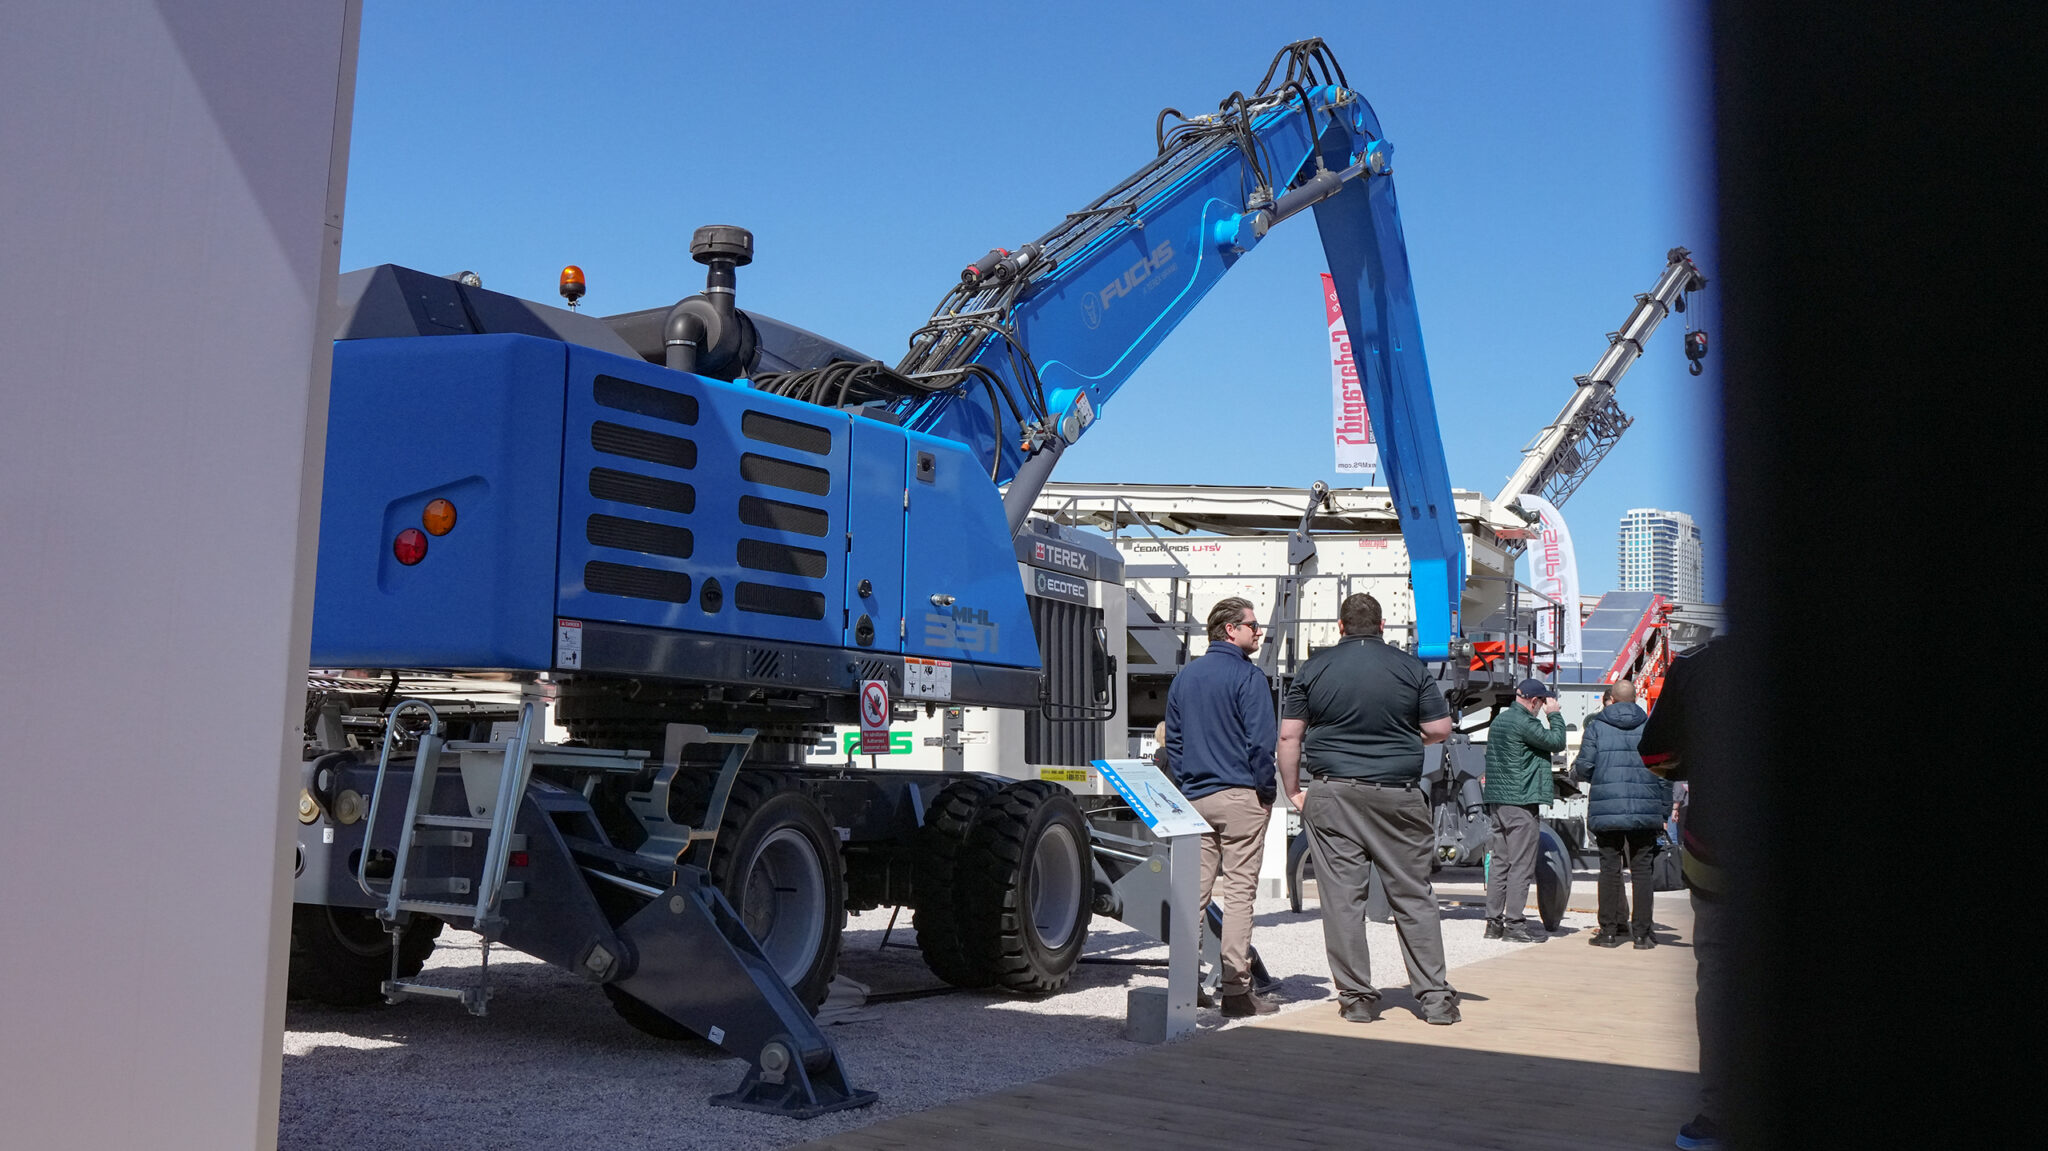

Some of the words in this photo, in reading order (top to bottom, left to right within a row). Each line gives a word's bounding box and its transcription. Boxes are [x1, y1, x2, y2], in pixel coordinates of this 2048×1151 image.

[1100, 239, 1174, 310] FUCHS
[1046, 544, 1087, 571] TEREX
[1047, 578, 1085, 598] ECOTEC
[952, 605, 995, 627] MHL
[925, 614, 999, 654] 331
